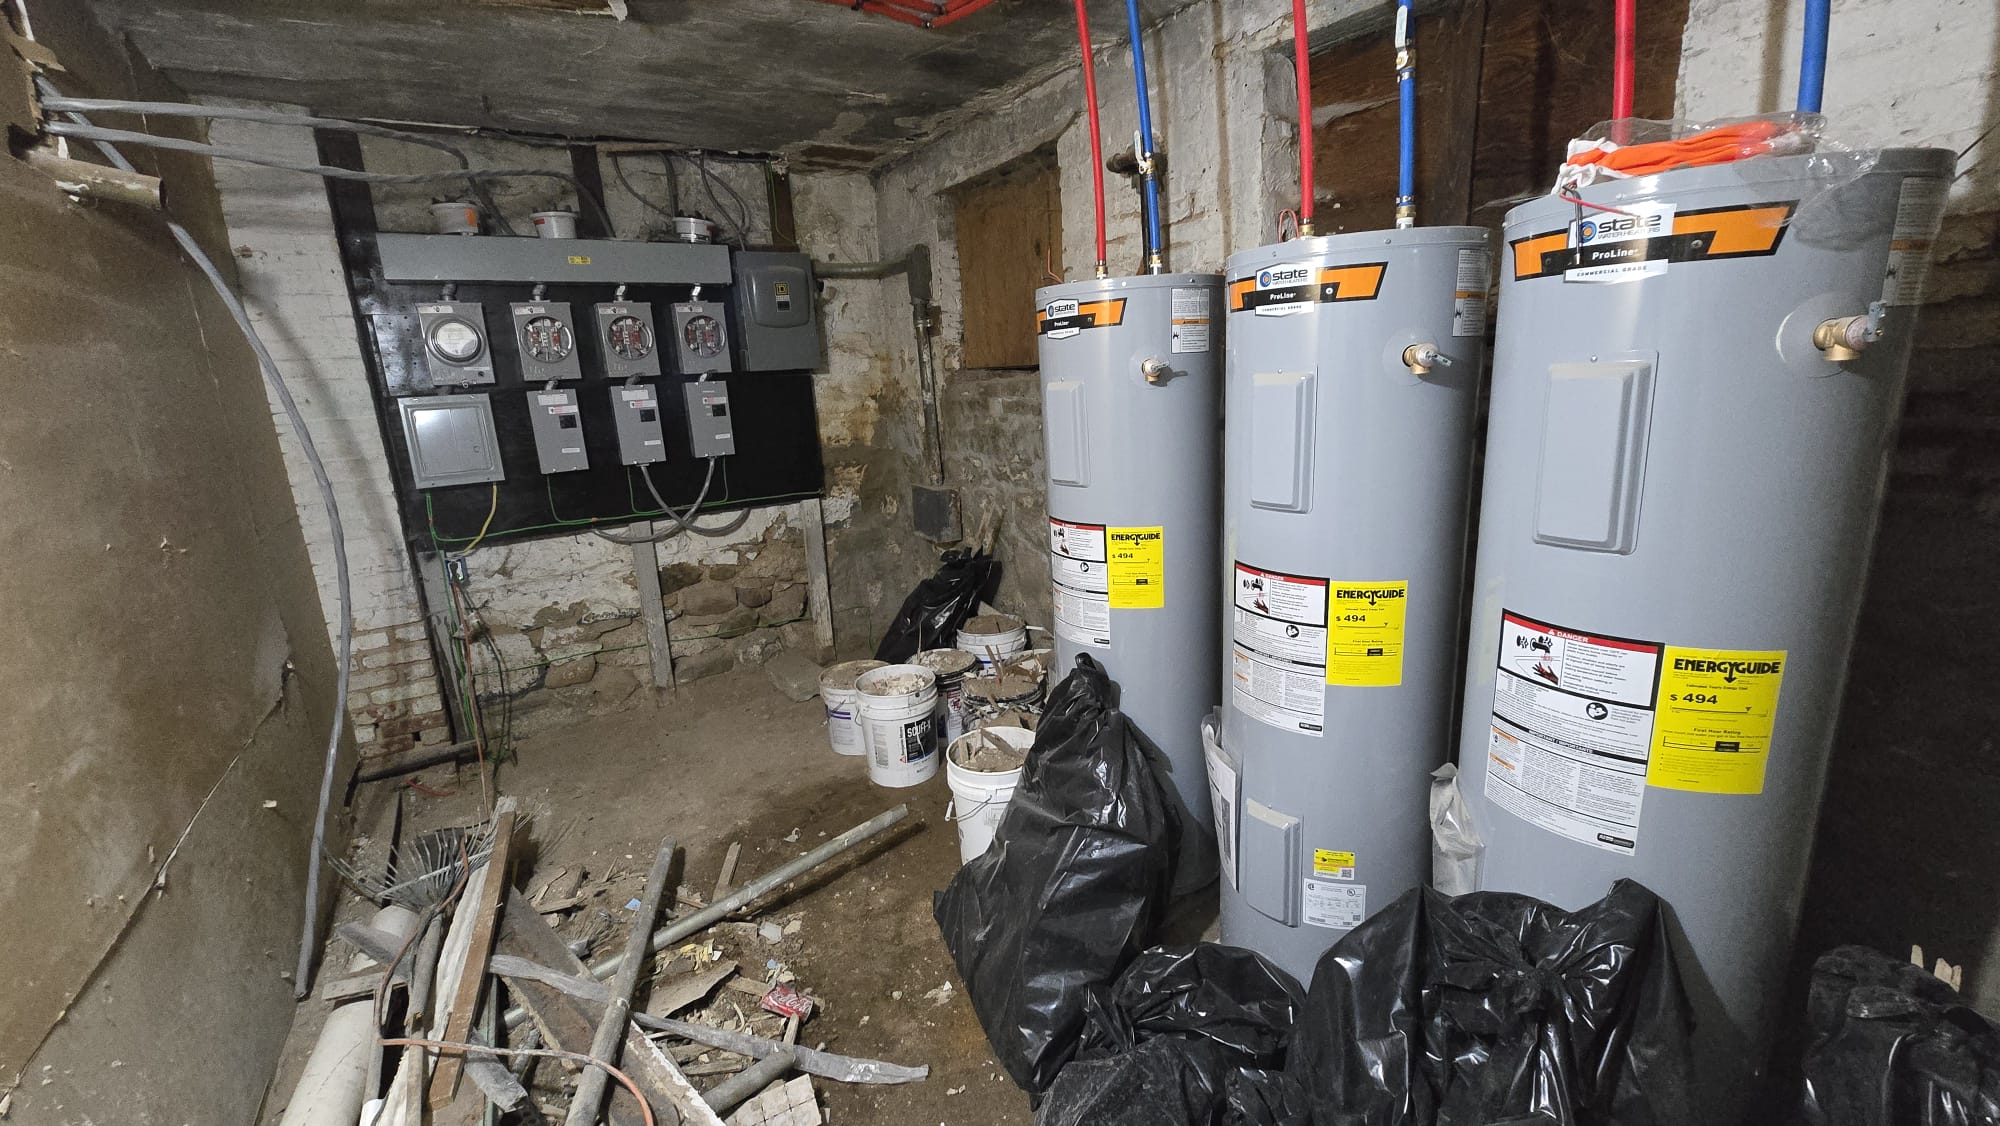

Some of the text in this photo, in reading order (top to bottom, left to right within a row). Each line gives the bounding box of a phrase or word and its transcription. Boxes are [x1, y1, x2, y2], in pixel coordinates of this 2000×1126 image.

[1598, 214, 1662, 233] state
[1592, 248, 1635, 260] ProLine
[1272, 268, 1308, 281] state
[1577, 267, 1619, 277] COMMERCIAL
[1054, 303, 1076, 313] state
[1111, 533, 1161, 542] ENERGYGUIDE
[1336, 589, 1405, 601] ENERGYGUIDE
[1343, 614, 1366, 622] 494
[1557, 631, 1589, 644] DANGER
[1673, 658, 1782, 676] ENERGYGUIDE
[1670, 693, 1718, 704] $ 494
